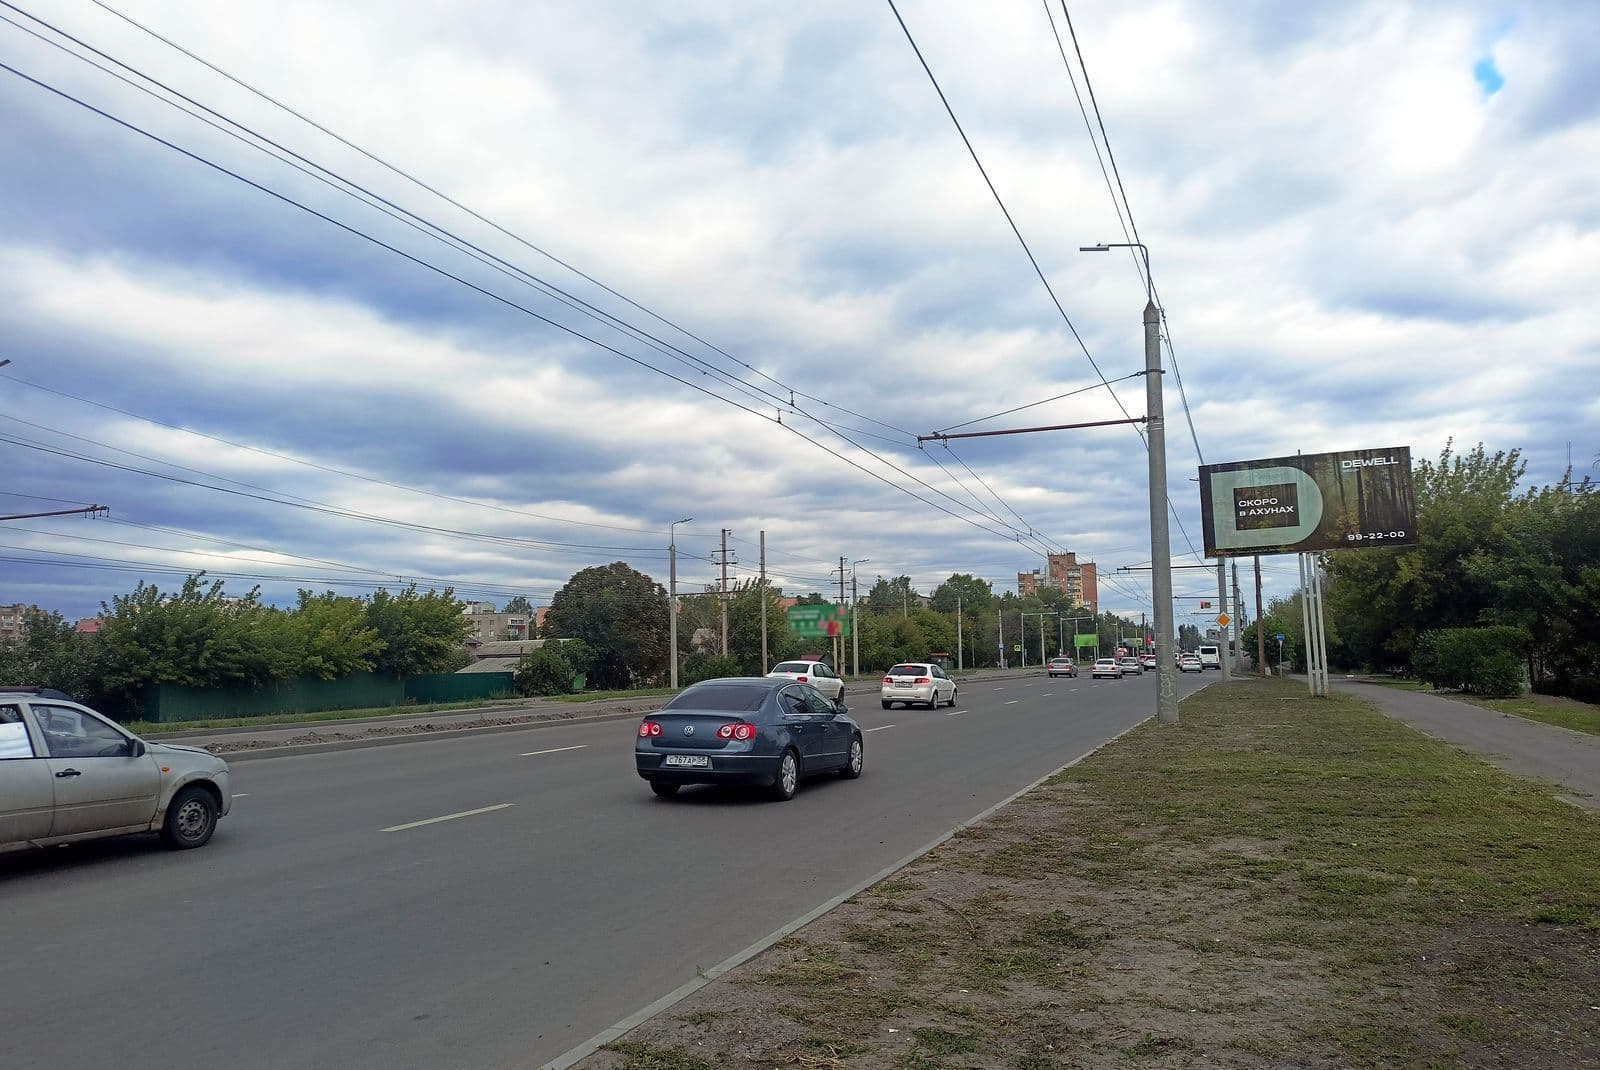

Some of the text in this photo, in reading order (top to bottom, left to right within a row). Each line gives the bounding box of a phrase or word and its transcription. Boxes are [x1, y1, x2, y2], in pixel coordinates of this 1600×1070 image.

[1342, 456, 1399, 468] DEWELL
[1238, 497, 1278, 507] СКОРО
[1249, 505, 1294, 516] АХУНАХ
[1347, 530, 1405, 541] 99-22-00
